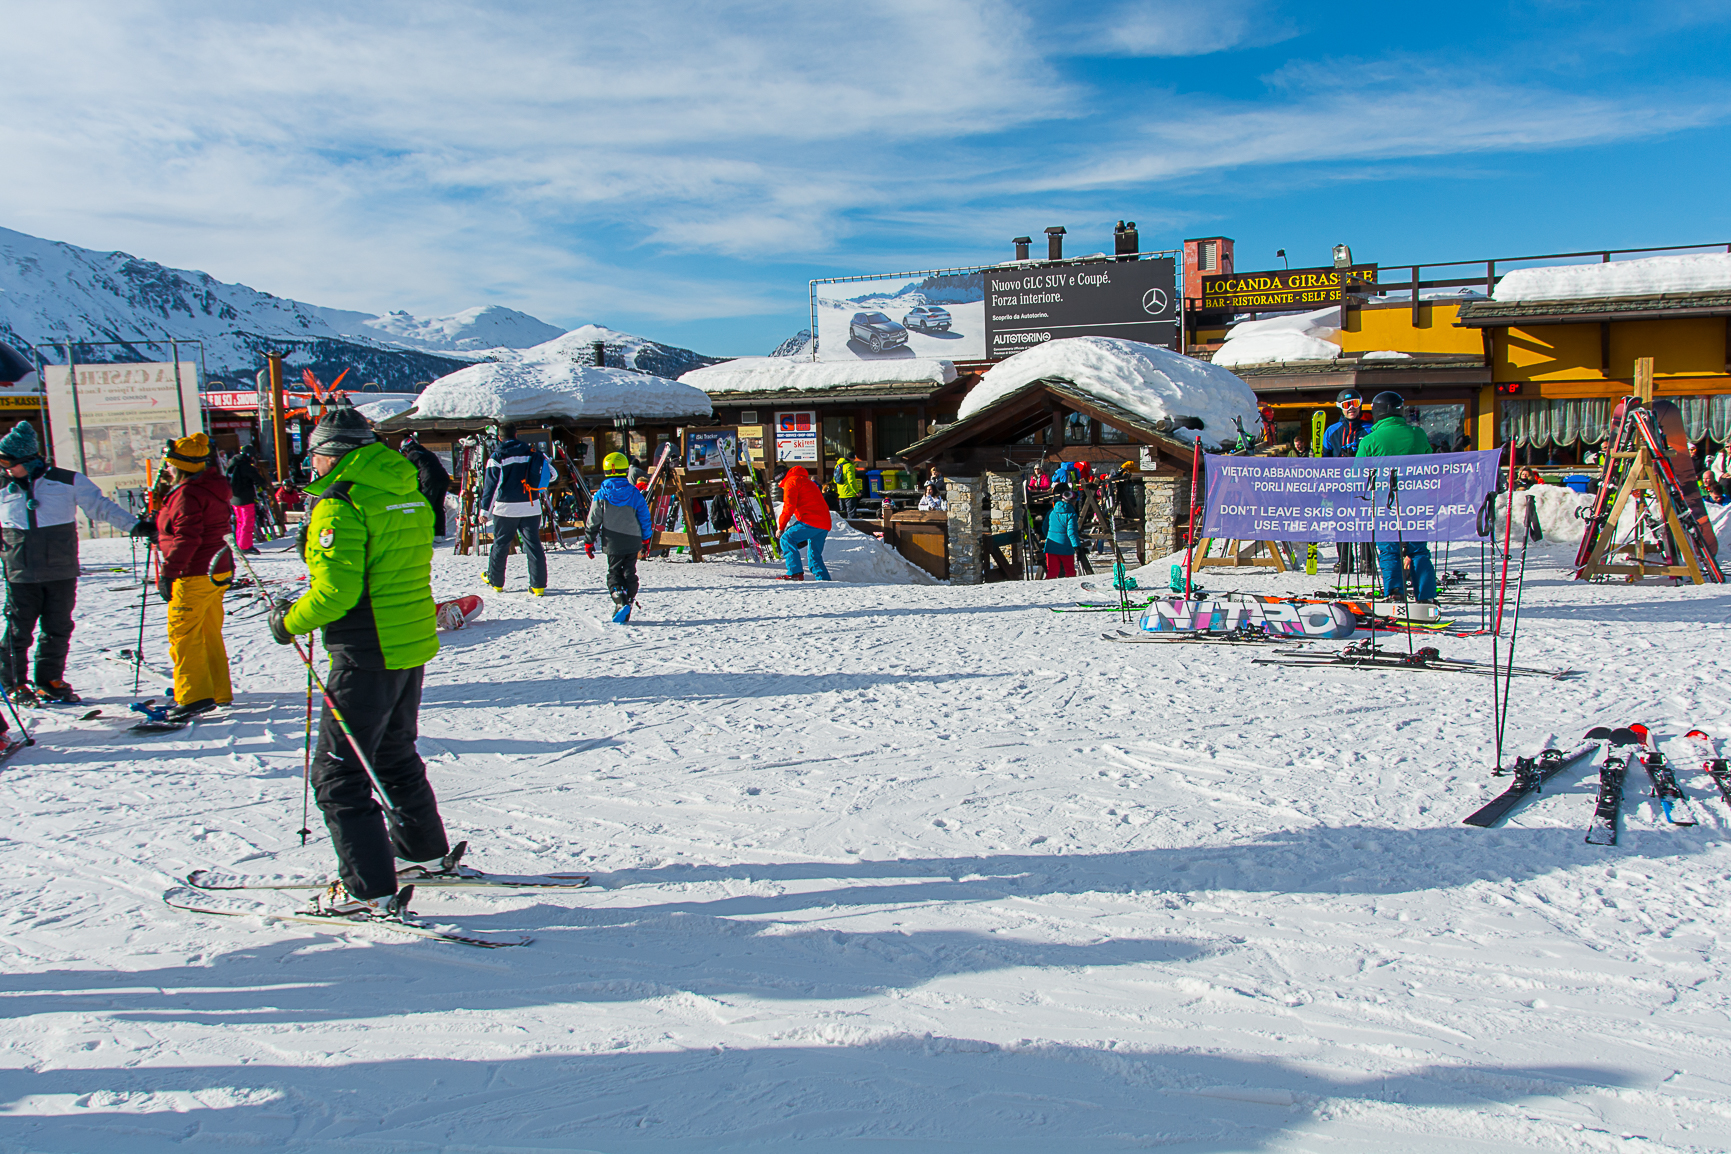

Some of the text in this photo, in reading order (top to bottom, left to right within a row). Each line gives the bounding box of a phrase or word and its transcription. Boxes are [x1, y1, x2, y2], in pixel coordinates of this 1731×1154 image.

[991, 271, 1111, 291] Nuovo GLC SUV e Coupé.
[1205, 270, 1373, 294] LOCANDA GIRASLE
[992, 292, 1064, 307] Forza interiore.
[1205, 298, 1225, 308] BAR
[1232, 294, 1294, 307] RISTORANTE
[1301, 291, 1326, 302] SELF
[992, 313, 1013, 321] Scoprilo
[993, 331, 1051, 345] AUTOTORINO
[1221, 466, 1261, 477] VIETATO
[1263, 468, 1341, 478] ABBANDONARE
[1343, 468, 1360, 478] GLI
[1406, 464, 1440, 476] PIANO
[1442, 462, 1474, 474] PISTA
[1476, 462, 1480, 472] !
[1254, 481, 1284, 492] PORLI
[1286, 482, 1316, 492] NEGLI
[1318, 482, 1365, 492] APPOSITI
[1220, 504, 1476, 517] DON'T LEAVE SKIS ON THE SLOPE AREA
[1254, 520, 1436, 531] USE THE APPOSITE HOLDER
[1142, 600, 1340, 635] NITRO
